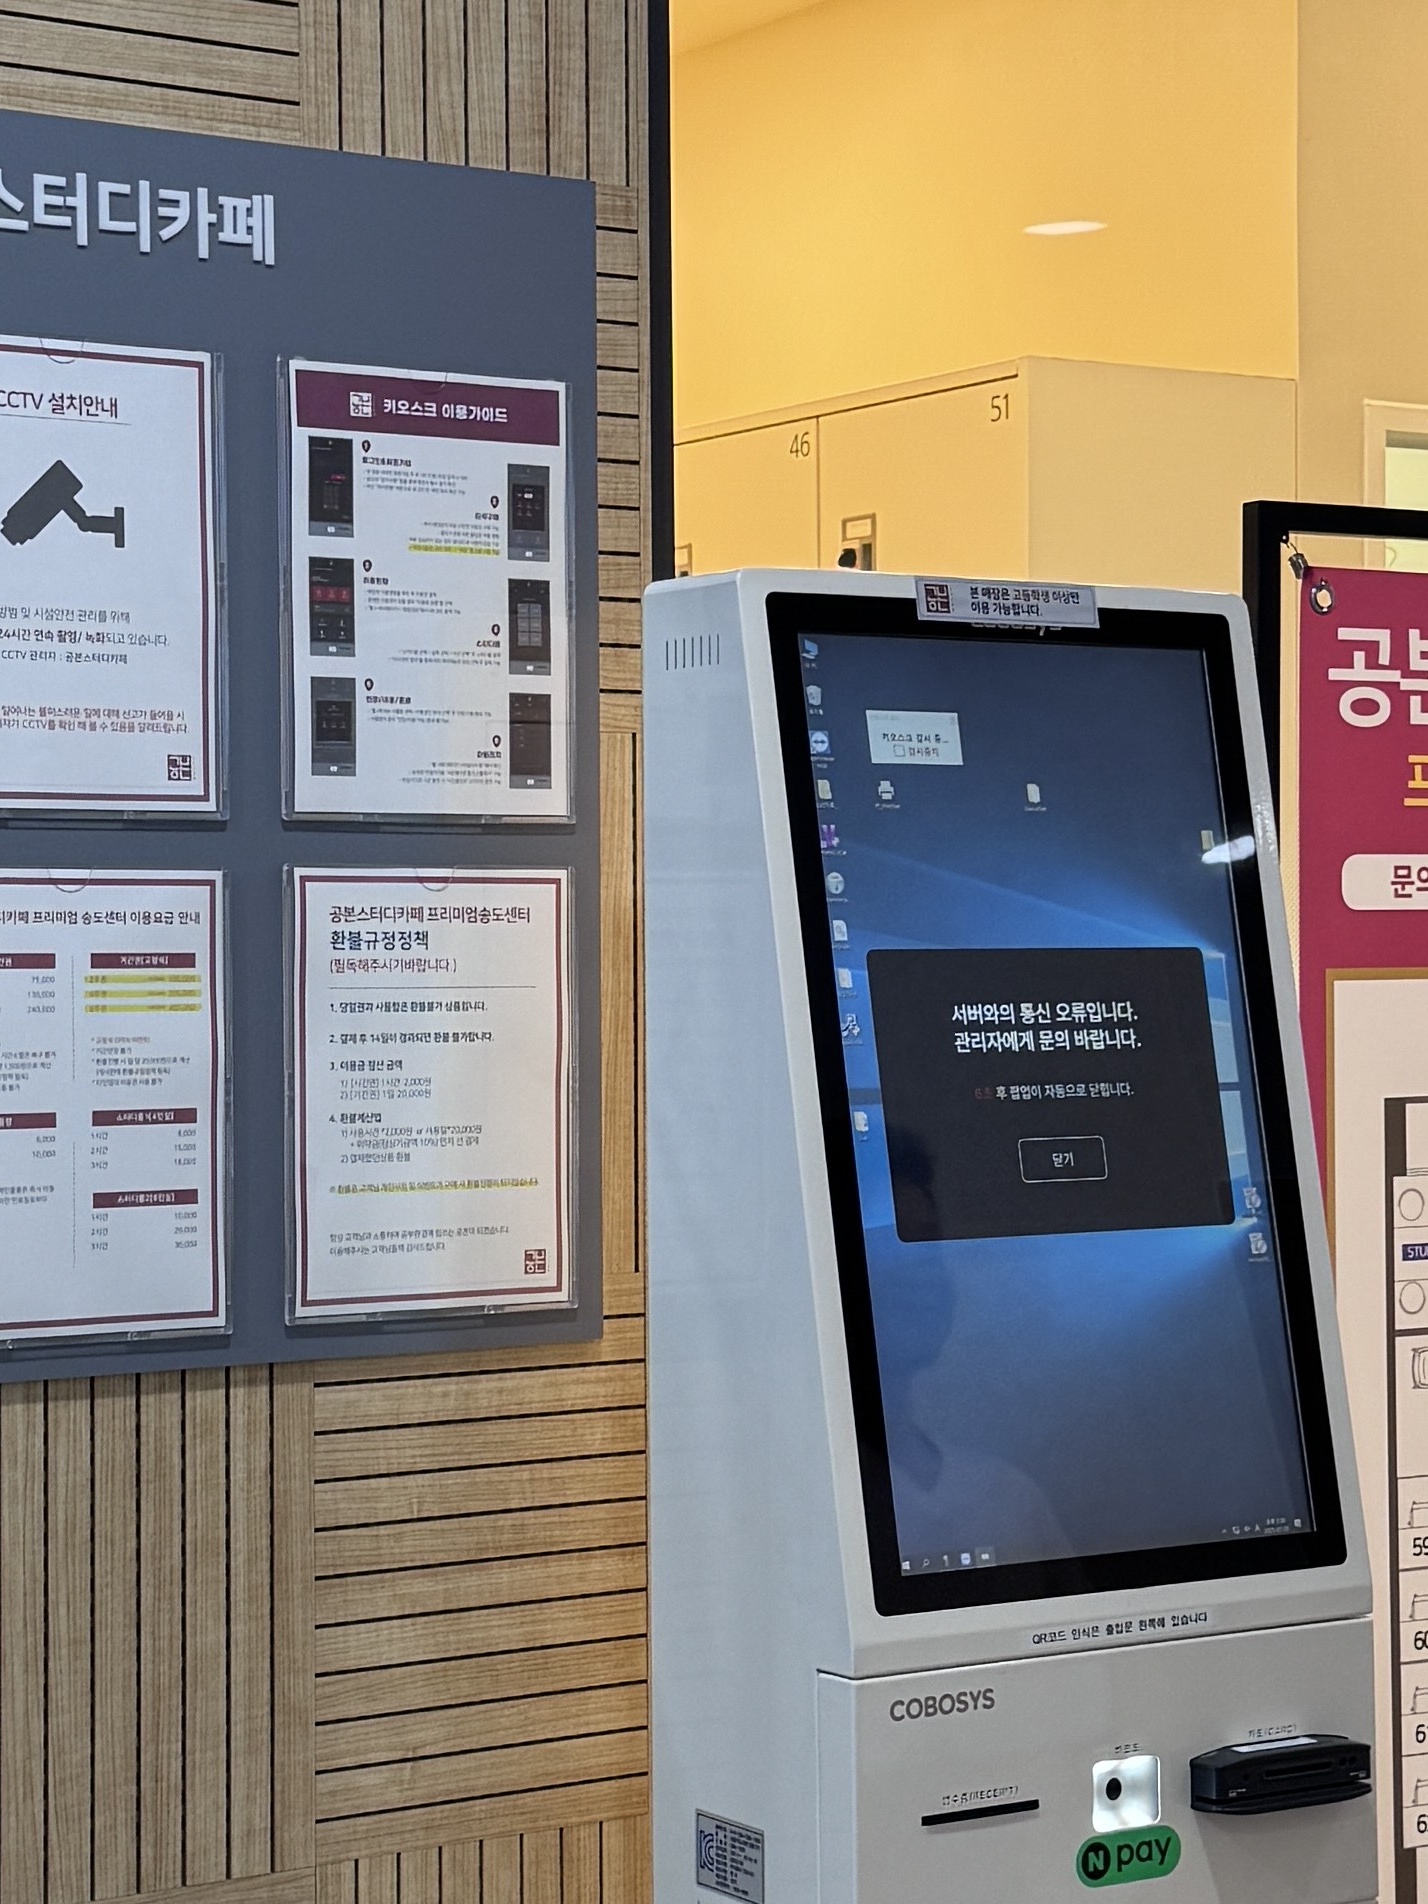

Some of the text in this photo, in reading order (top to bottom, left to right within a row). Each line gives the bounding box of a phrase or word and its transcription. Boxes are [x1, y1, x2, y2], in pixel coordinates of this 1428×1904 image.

[48, 391, 118, 419] 설치안내
[383, 399, 507, 423] 키오스크 이용가이드
[990, 393, 1010, 423] 51
[790, 431, 811, 459] 46
[32, 910, 78, 925] 프리미엄
[82, 910, 127, 925] 송도센터
[131, 911, 174, 925] 이용요금
[178, 911, 200, 925] 안내
[330, 906, 530, 923] 공본스터디카페 프리미엄송도센터
[330, 931, 429, 950] 환불규정정책
[951, 1002, 1138, 1025] 서버와의 통신 오류입니다.
[954, 1028, 1141, 1053] 관리자에게 문의 바랍니다.
[996, 1085, 1006, 1100] 후
[1010, 1084, 1042, 1099] 팝업이
[1044, 1083, 1087, 1099] 자동으로
[1052, 1153, 1074, 1167] 닫기
[1032, 1628, 1067, 1645] QR코드
[890, 1688, 995, 1722] COBOSYS
[1116, 1834, 1172, 1873] pay
